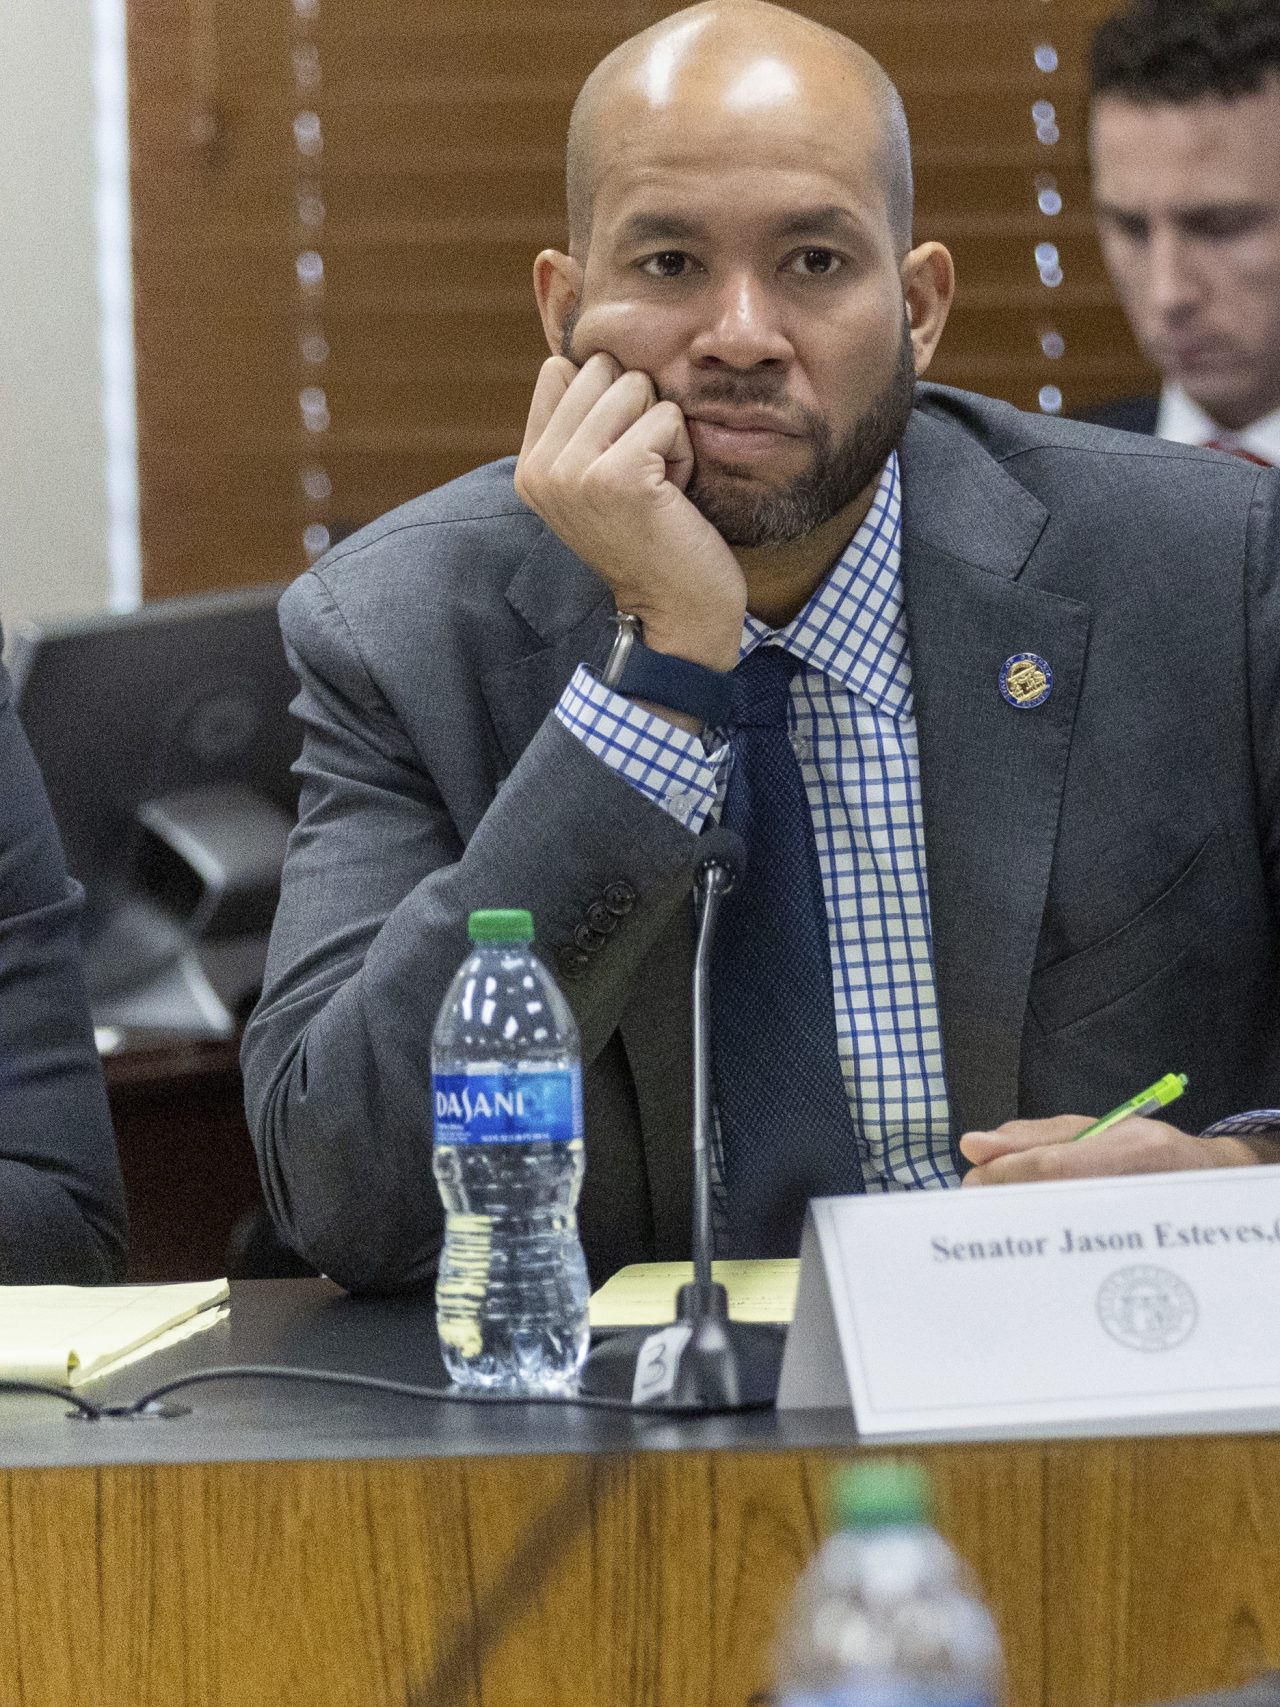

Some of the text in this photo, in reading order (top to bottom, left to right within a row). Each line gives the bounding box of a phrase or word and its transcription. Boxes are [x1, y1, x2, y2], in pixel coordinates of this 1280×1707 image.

[435, 1087, 525, 1123] DASANI
[931, 1235, 1047, 1263] Senator
[1059, 1227, 1144, 1254] Jason
[641, 1343, 667, 1389] 3
